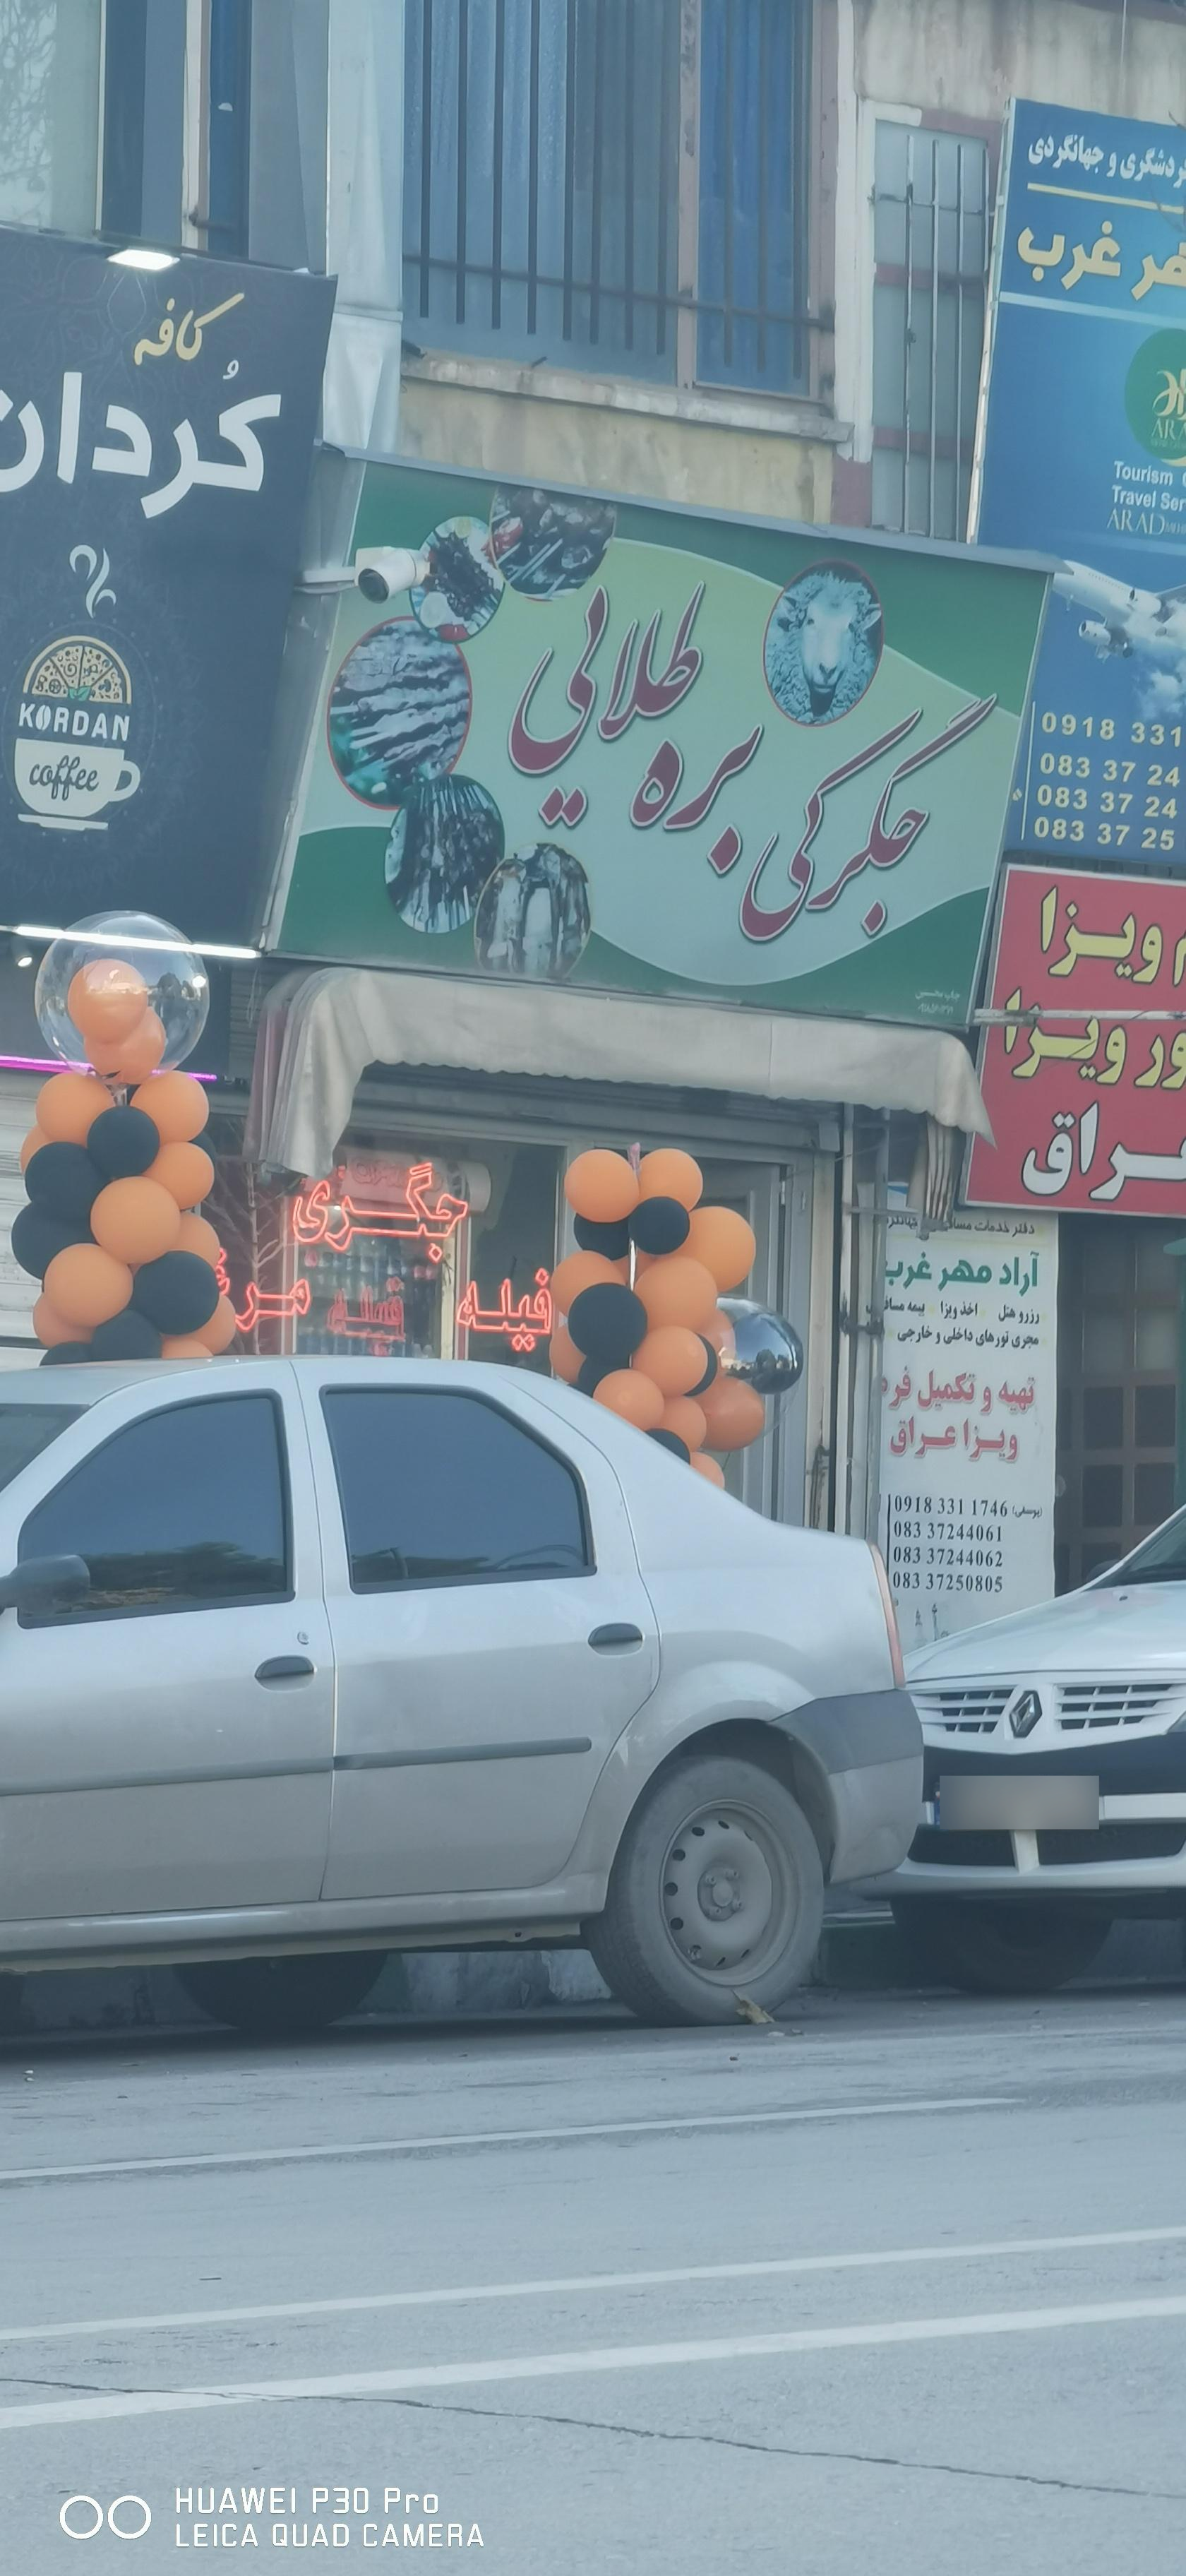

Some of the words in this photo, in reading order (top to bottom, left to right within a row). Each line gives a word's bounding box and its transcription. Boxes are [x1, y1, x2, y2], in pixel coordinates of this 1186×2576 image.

[1028, 134, 1104, 174] جهانگردی
[1106, 152, 1117, 177] و
[1120, 147, 1186, 189] ردشگری
[1017, 220, 1121, 290] غرب
[1131, 241, 1186, 302] هر
[134, 292, 245, 365] کافه
[1151, 417, 1186, 441] ARA
[1113, 460, 1174, 487] Tourism
[1111, 484, 1156, 508] Travel
[1160, 492, 1186, 513] Ser
[18, 703, 131, 742] KORDAN
[1041, 712, 1115, 741] 0918
[1131, 722, 1182, 748] 331
[29, 754, 100, 801] coffee
[1039, 752, 1091, 778] 083
[1103, 759, 1136, 782] 37
[1146, 764, 1180, 788] 24
[630, 724, 764, 875] بره
[1036, 784, 1088, 810] 083
[1100, 791, 1133, 814] 37
[1144, 796, 1178, 819] 24
[1034, 816, 1085, 842] 083
[1097, 822, 1130, 846] 37
[1141, 827, 1175, 851] 25
[1041, 885, 1163, 984] ویزا
[1005, 986, 1128, 1085] ویزا
[1134, 1031, 1186, 1090] ور
[292, 1162, 469, 1264] جگری
[974, 1220, 1010, 1234] خدمات
[1012, 1221, 1036, 1237] دفتر
[884, 1251, 932, 1289] غرب
[937, 1259, 993, 1292] مهر
[998, 1251, 1040, 1297] آراد
[455, 1267, 553, 1354] فیله
[906, 1301, 926, 1317] بیمه
[940, 1300, 958, 1320] ویزا
[959, 1302, 978, 1317] اخذ
[998, 1304, 1017, 1322] هتل
[1018, 1308, 1040, 1325] رزرو
[897, 1325, 933, 1343] خارجی
[934, 1332, 941, 1344] و
[942, 1326, 974, 1344] داخلی
[1011, 1332, 1040, 1349] مجری
[917, 1368, 976, 1408] تکمیل
[980, 1386, 993, 1414] و
[998, 1377, 1036, 1412] تهیه
[889, 1415, 957, 1459] عراق
[962, 1417, 1019, 1462] ویزا
[894, 1494, 933, 1515] 0918
[937, 1497, 964, 1515] 331
[971, 1499, 1008, 1517] 1746
[893, 1520, 922, 1539] 083
[927, 1523, 1002, 1543] 37244061
[893, 1546, 921, 1564] 083
[926, 1548, 1003, 1568] 37244062
[892, 1571, 921, 1589] 083
[926, 1573, 1003, 1593] 37250805
